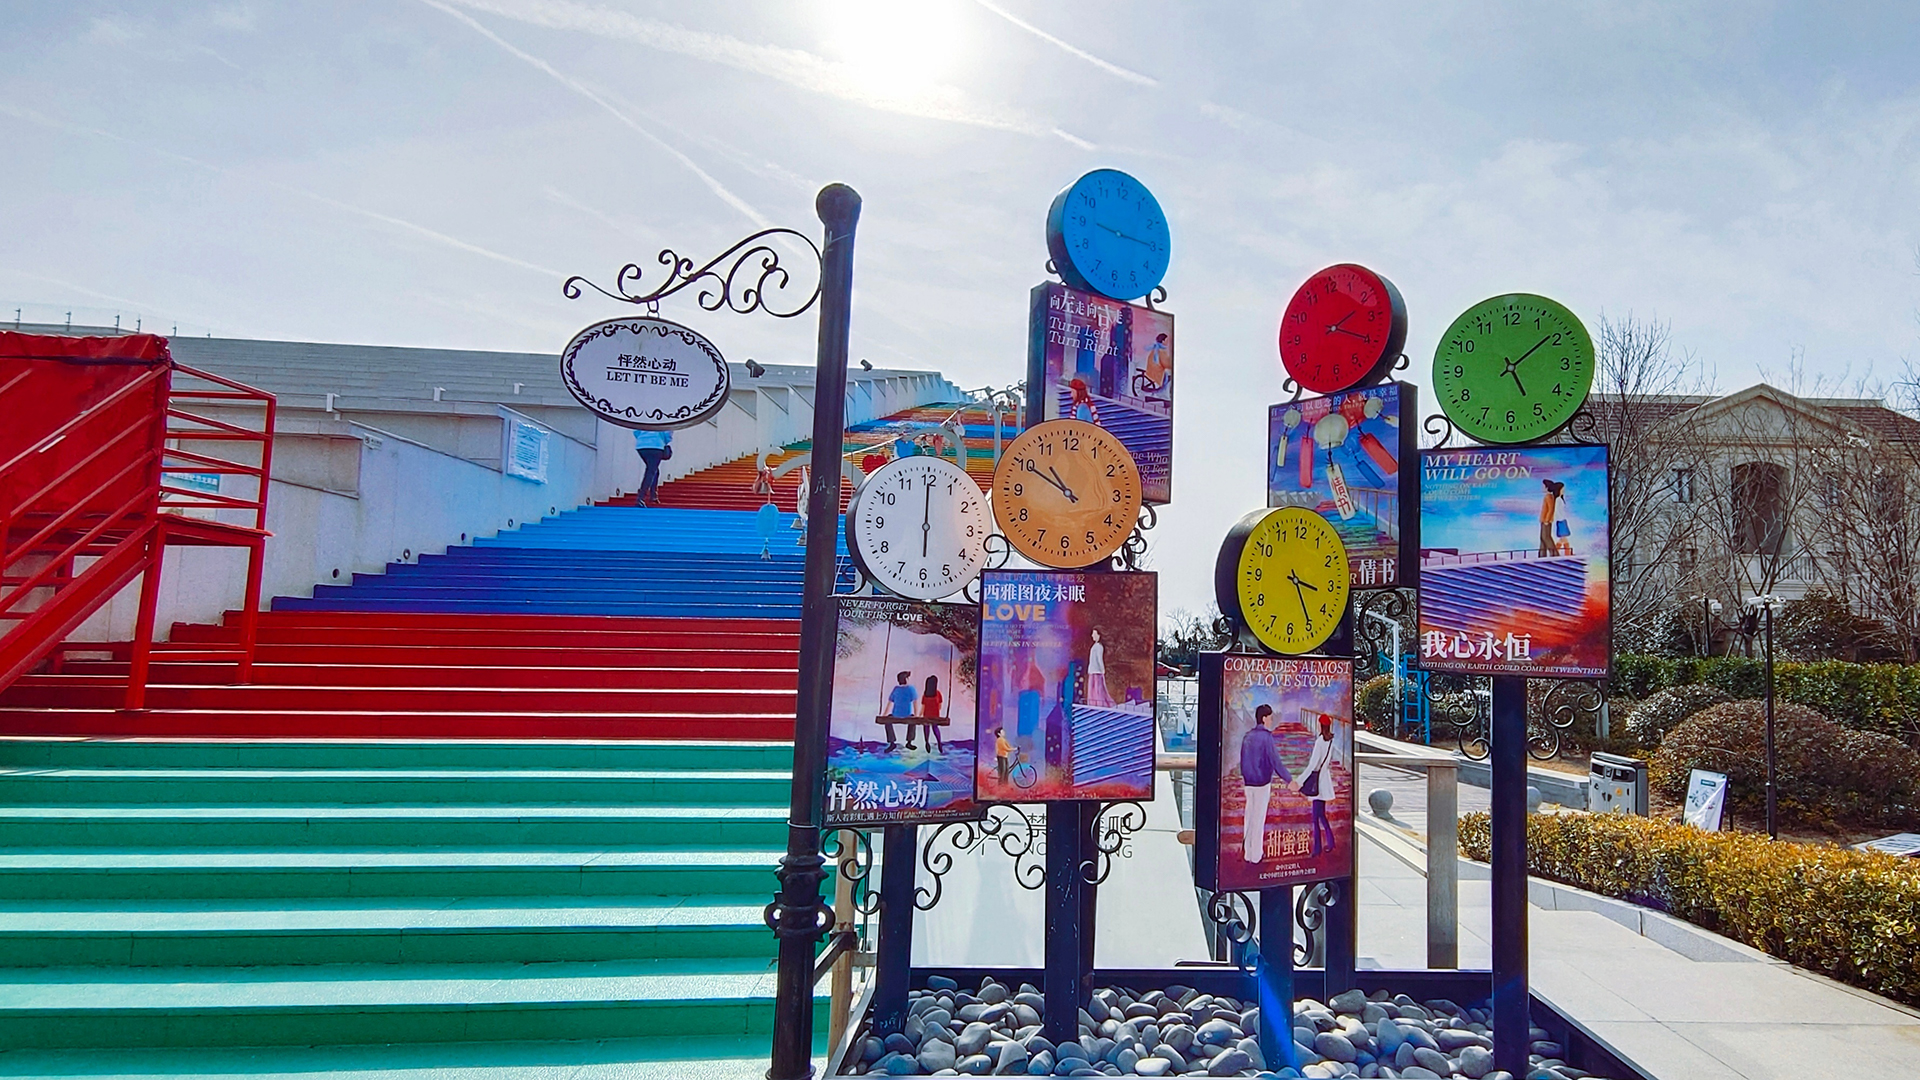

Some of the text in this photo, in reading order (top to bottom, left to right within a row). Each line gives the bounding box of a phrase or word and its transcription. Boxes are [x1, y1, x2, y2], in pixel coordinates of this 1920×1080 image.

[1099, 187, 1109, 198] 11
[1117, 188, 1128, 200] 12
[1084, 195, 1096, 208] 10
[1137, 201, 1141, 211] 1
[1080, 216, 1086, 226] 9
[1146, 219, 1153, 230] 2
[1082, 238, 1089, 249] 8
[1150, 241, 1156, 251] 3
[1095, 259, 1101, 270] 7
[1143, 261, 1149, 270] 4
[1111, 270, 1118, 281] 6
[1130, 271, 1136, 281] 5
[1325, 281, 1337, 294] 12
[1347, 282, 1352, 291] 1
[1308, 294, 1318, 305] 11
[1361, 291, 1368, 303] 2
[1050, 290, 1124, 329] 向左走向右走
[1295, 312, 1307, 324] 10
[1368, 311, 1375, 322] 3
[1502, 312, 1520, 326] 12
[1050, 316, 1110, 341] Turn Left
[1477, 322, 1492, 335] 11
[1534, 318, 1540, 330] 1
[1050, 330, 1118, 357] Turn Right
[1294, 335, 1300, 345] 9
[1364, 334, 1371, 344] 4
[1552, 333, 1562, 346] 2
[1458, 340, 1474, 353] 10
[618, 354, 676, 371] 怦然心动
[1301, 353, 1307, 364] 8
[1352, 353, 1358, 364] 5
[1560, 357, 1570, 370] 3
[1315, 365, 1321, 376] 7
[1333, 364, 1339, 375] 6
[1454, 365, 1464, 378] 9
[607, 371, 688, 387] LET IT BE ME
[1461, 389, 1470, 402] 8
[1552, 383, 1562, 396] 4
[1481, 407, 1490, 419] 7
[1533, 403, 1542, 416] 5
[1506, 410, 1515, 423] 6
[1038, 443, 1052, 455] 11
[1062, 438, 1079, 451] 12
[1091, 447, 1097, 459] 1
[1425, 452, 1521, 467] MY HEART
[1018, 459, 1035, 472] 10
[1106, 464, 1115, 477] 2
[1425, 466, 1533, 481] WILL GO ON
[899, 478, 912, 490] 11
[921, 474, 936, 487] 12
[947, 484, 953, 495] 1
[1014, 483, 1023, 496] 9
[1112, 490, 1121, 502] 3
[880, 492, 896, 505] 10
[961, 501, 969, 513] 2
[1019, 508, 1028, 521] 8
[1104, 514, 1112, 526] 4
[876, 516, 884, 529] 9
[966, 525, 974, 537] 3
[1037, 529, 1046, 542] 7
[1276, 529, 1287, 543] 11
[1294, 526, 1307, 539] 12
[1061, 536, 1069, 548] 6
[1086, 532, 1094, 544] 5
[1315, 537, 1320, 549] 1
[880, 540, 889, 553] 8
[1260, 544, 1273, 557] 10
[958, 548, 966, 560] 4
[898, 561, 906, 573] 7
[1325, 555, 1332, 568] 2
[919, 568, 927, 580] 6
[942, 564, 950, 576] 5
[1255, 568, 1262, 581] 9
[1358, 558, 1395, 585] 情书
[1327, 580, 1334, 592] 3
[983, 583, 1086, 603] 西雅图夜未眠
[1257, 593, 1264, 606] 8
[839, 599, 911, 611] NEVER FORGET
[1320, 603, 1327, 615] 4
[838, 608, 923, 622] YOUR FIRST LOVE
[982, 604, 1046, 621] LOVE
[1270, 615, 1277, 628] 7
[1305, 619, 1312, 632] 5
[1287, 623, 1293, 635] 6
[1420, 630, 1533, 662] 我心永恒
[1224, 658, 1352, 674] COMRADES ALMOST
[1420, 661, 1454, 669] NOTHING
[1243, 673, 1334, 687] A LOVE STORY
[827, 779, 929, 811] 怦然心动
[1267, 828, 1311, 858] 甜蜜蜜
